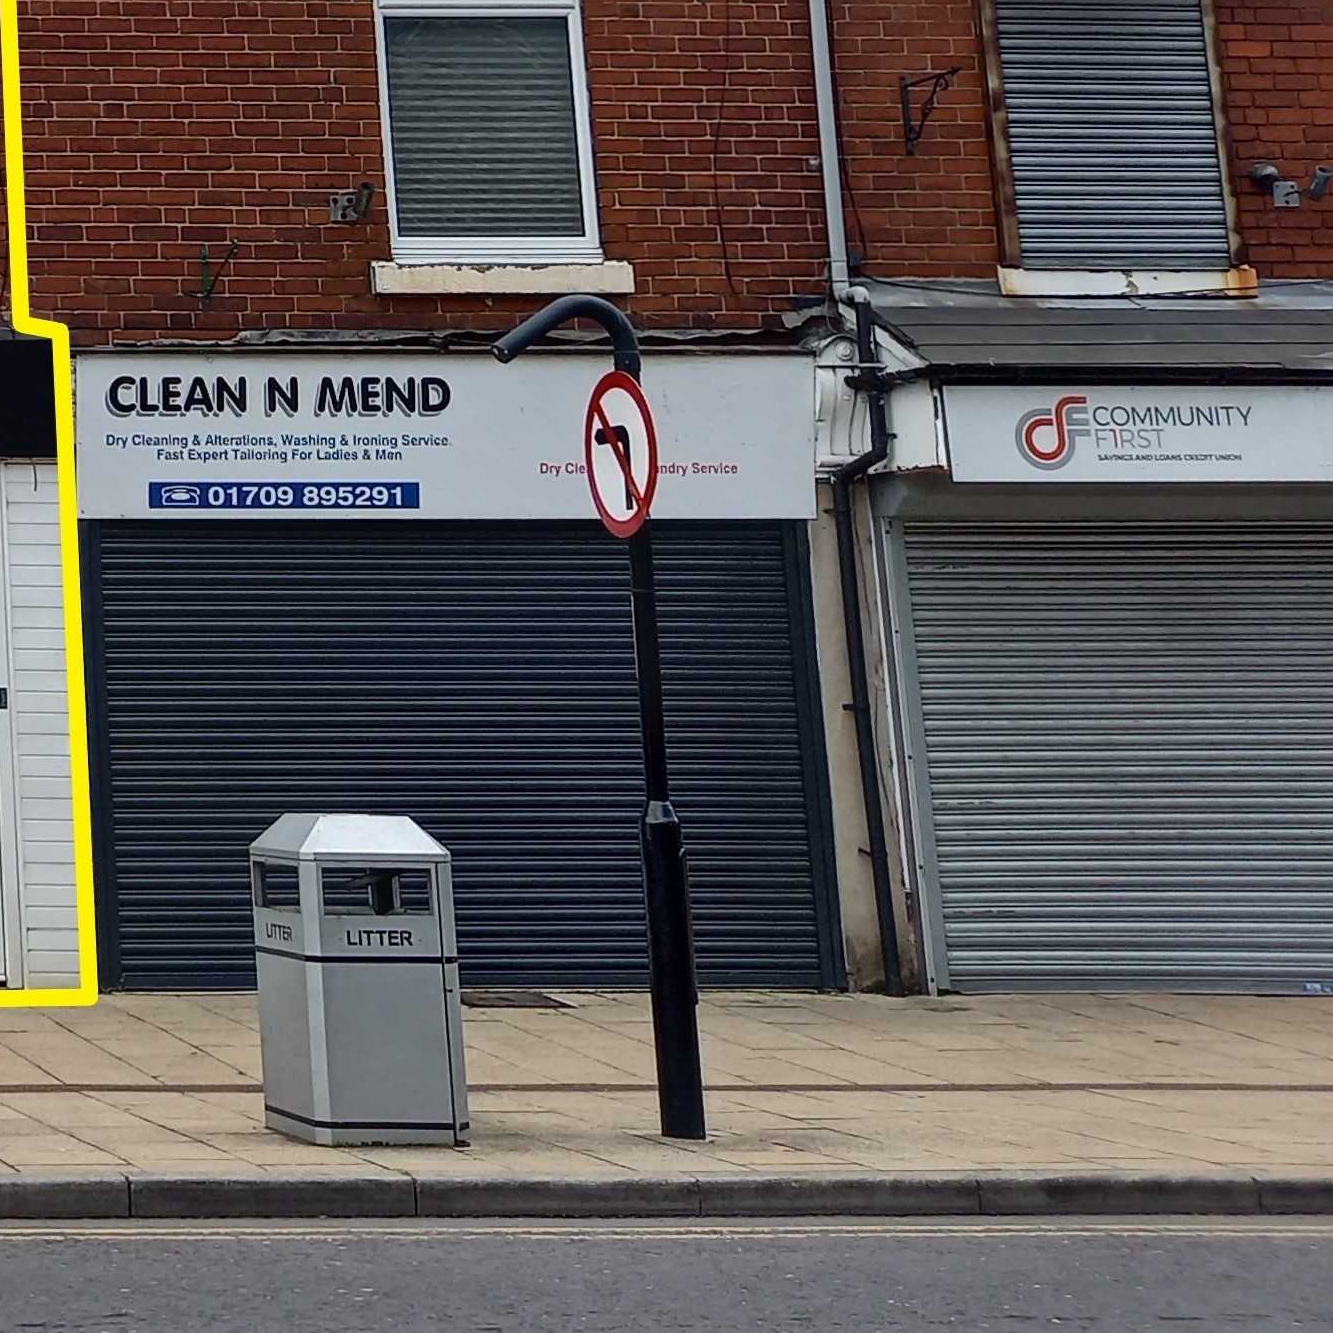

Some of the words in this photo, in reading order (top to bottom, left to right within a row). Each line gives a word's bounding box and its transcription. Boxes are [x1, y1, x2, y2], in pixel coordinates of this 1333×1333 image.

[105, 376, 247, 417] CLEAN
[264, 376, 299, 417] N
[314, 376, 451, 417] MEND
[1093, 405, 1252, 427] COMMUNITY
[105, 434, 128, 449] Dry
[132, 434, 188, 449] Cleaning
[191, 434, 201, 447] &
[281, 434, 336, 449] Washing
[339, 434, 349, 447] &
[353, 434, 398, 449] Ironing
[156, 449, 184, 461] Fast
[188, 449, 229, 464] Expert
[232, 449, 287, 464] Tailoring
[291, 449, 312, 461] For
[316, 449, 359, 461] Ladies
[362, 449, 372, 461] &
[375, 449, 403, 461] Men
[1134, 453, 1153, 462] AND
[540, 462, 561, 477] Dry
[692, 462, 738, 475] Service
[207, 486, 294, 506] 01709
[302, 486, 402, 506] 895291
[265, 922, 293, 942] LITTER
[346, 929, 414, 947] LITTER
